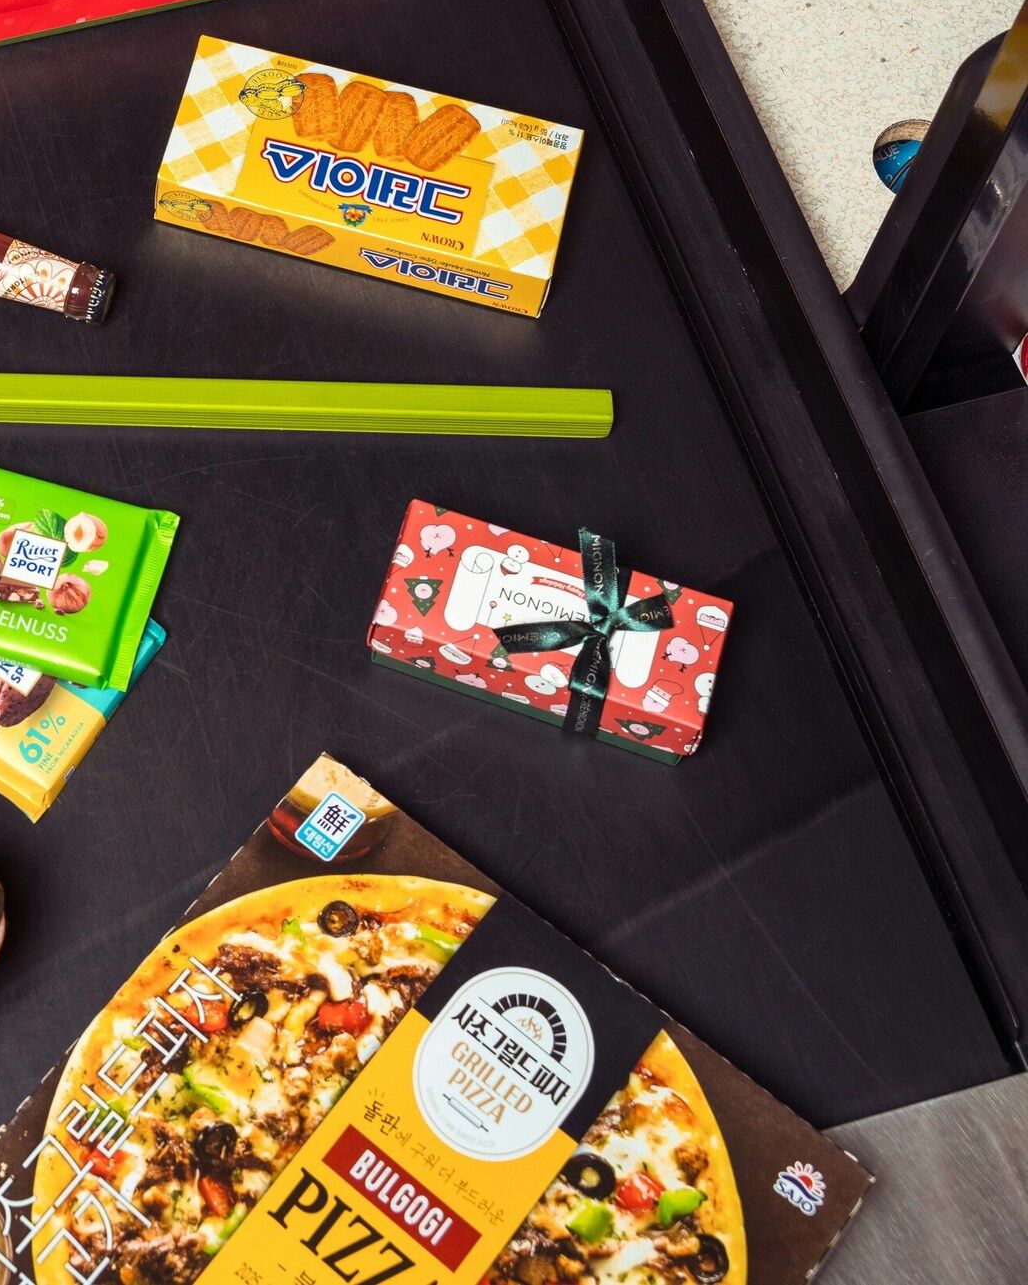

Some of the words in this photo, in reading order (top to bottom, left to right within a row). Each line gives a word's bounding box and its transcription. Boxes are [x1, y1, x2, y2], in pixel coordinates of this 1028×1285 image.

[262, 139, 471, 225] 그레이스
[421, 230, 465, 251] CROWN
[359, 247, 513, 301] 그레이스
[9, 557, 55, 578] SPORT
[15, 537, 60, 562] Ritter
[18, 713, 67, 764] 61%
[38, 751, 55, 771] FINE
[302, 825, 336, 856] 대림선
[315, 803, 352, 840] 鮮
[447, 1067, 506, 1126] PIZZA
[449, 1040, 534, 1117] GRILLED
[362, 1100, 410, 1145] 돌판에
[452, 1174, 506, 1227] 부드러운
[349, 1147, 455, 1248] BULGOGI
[775, 1178, 817, 1216] SAJO
[267, 1167, 418, 1285] PIZZ
